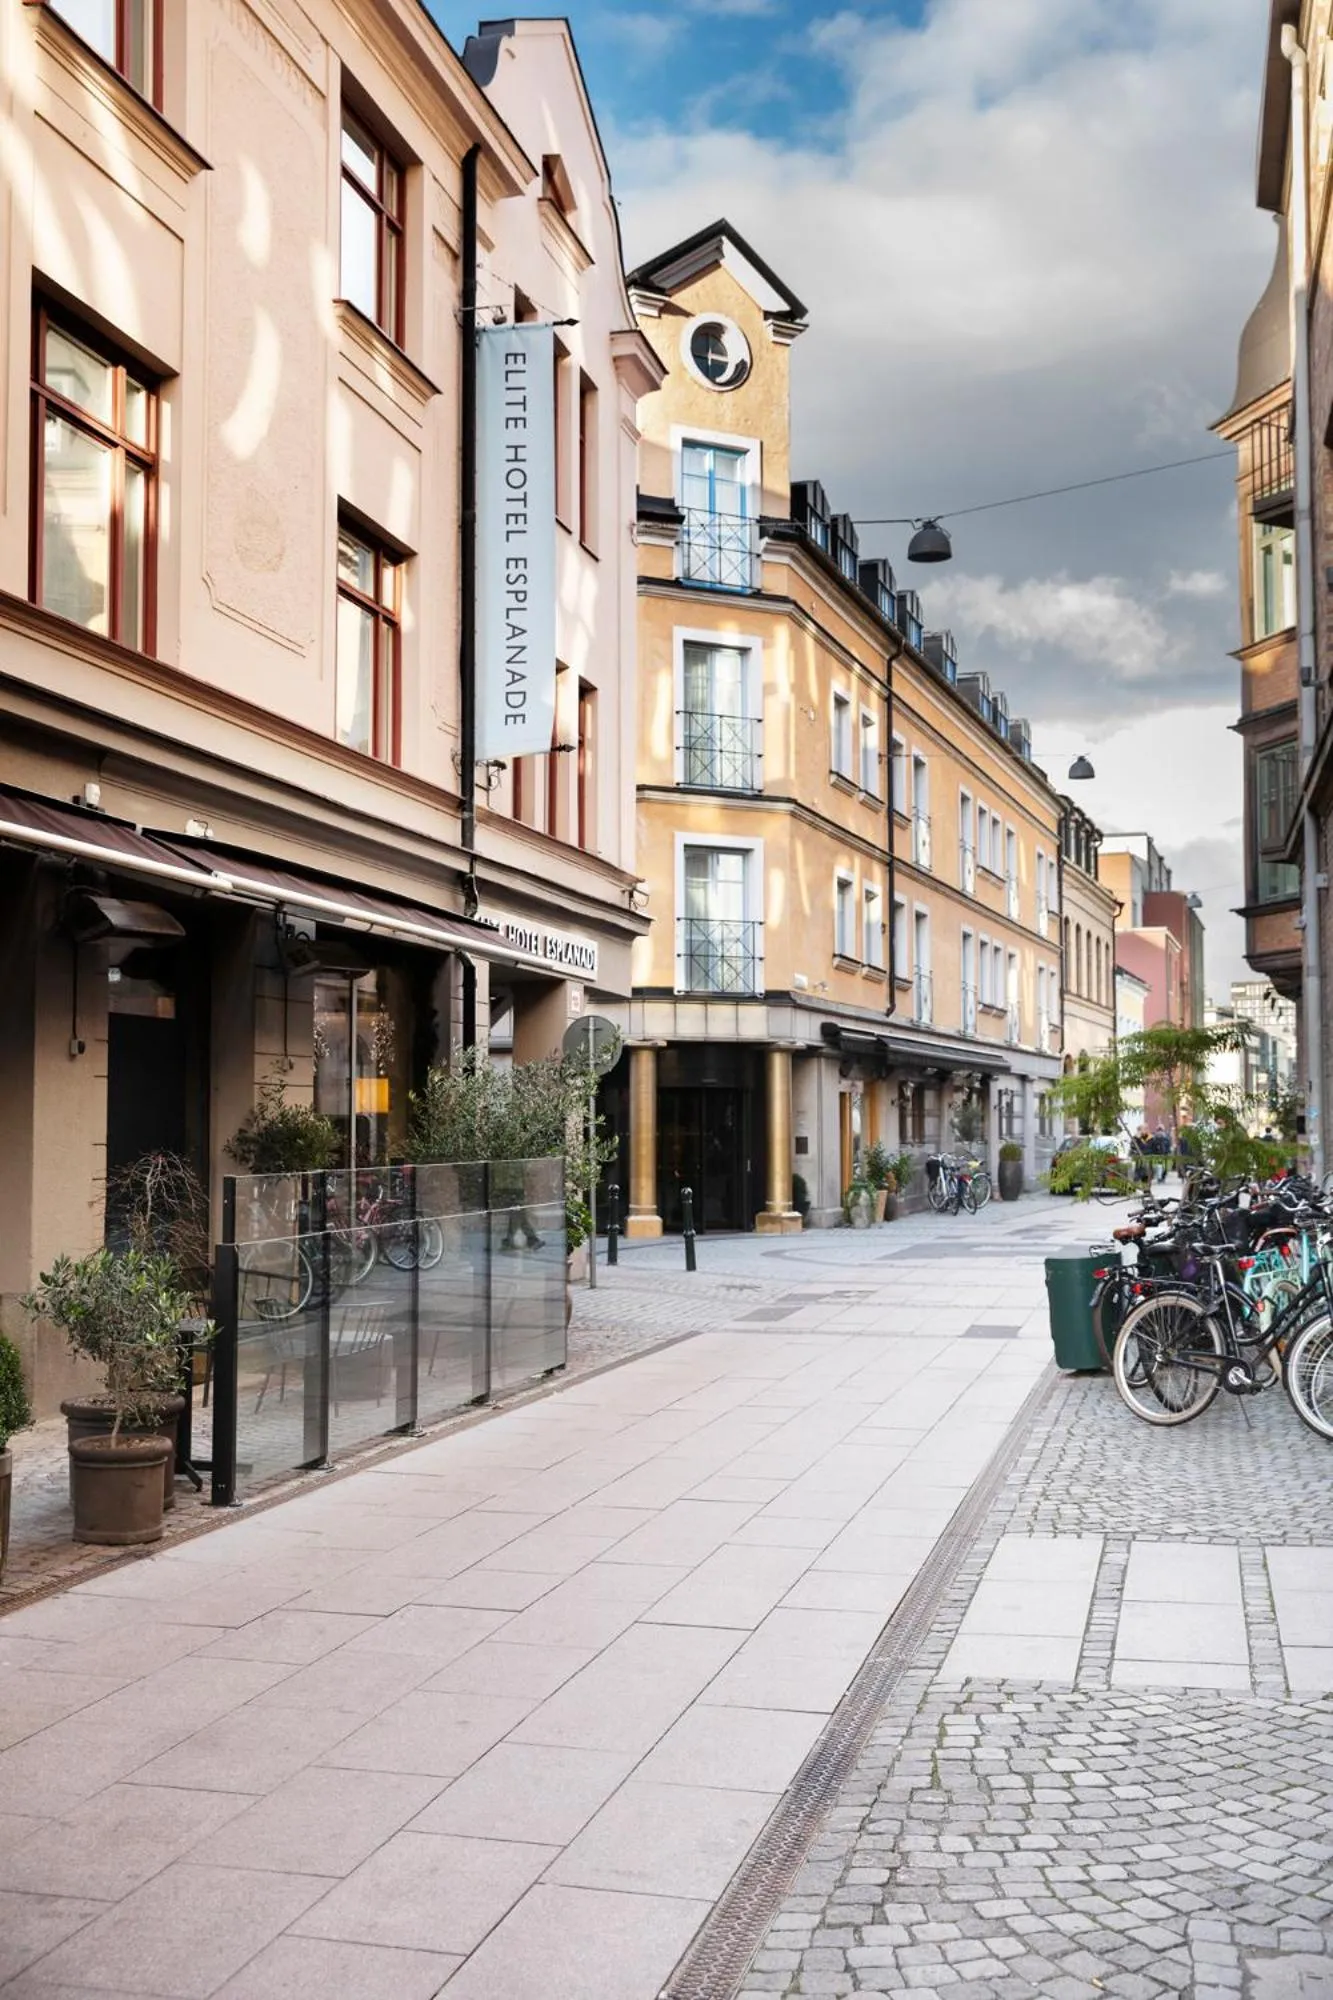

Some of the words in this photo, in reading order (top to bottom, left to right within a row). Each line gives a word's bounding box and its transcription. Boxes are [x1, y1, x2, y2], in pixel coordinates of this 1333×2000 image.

[504, 352, 527, 430] ELITE
[504, 444, 527, 543] HOTEL
[504, 557, 527, 726] ESPLANADE
[507, 925, 543, 956] HOTEL
